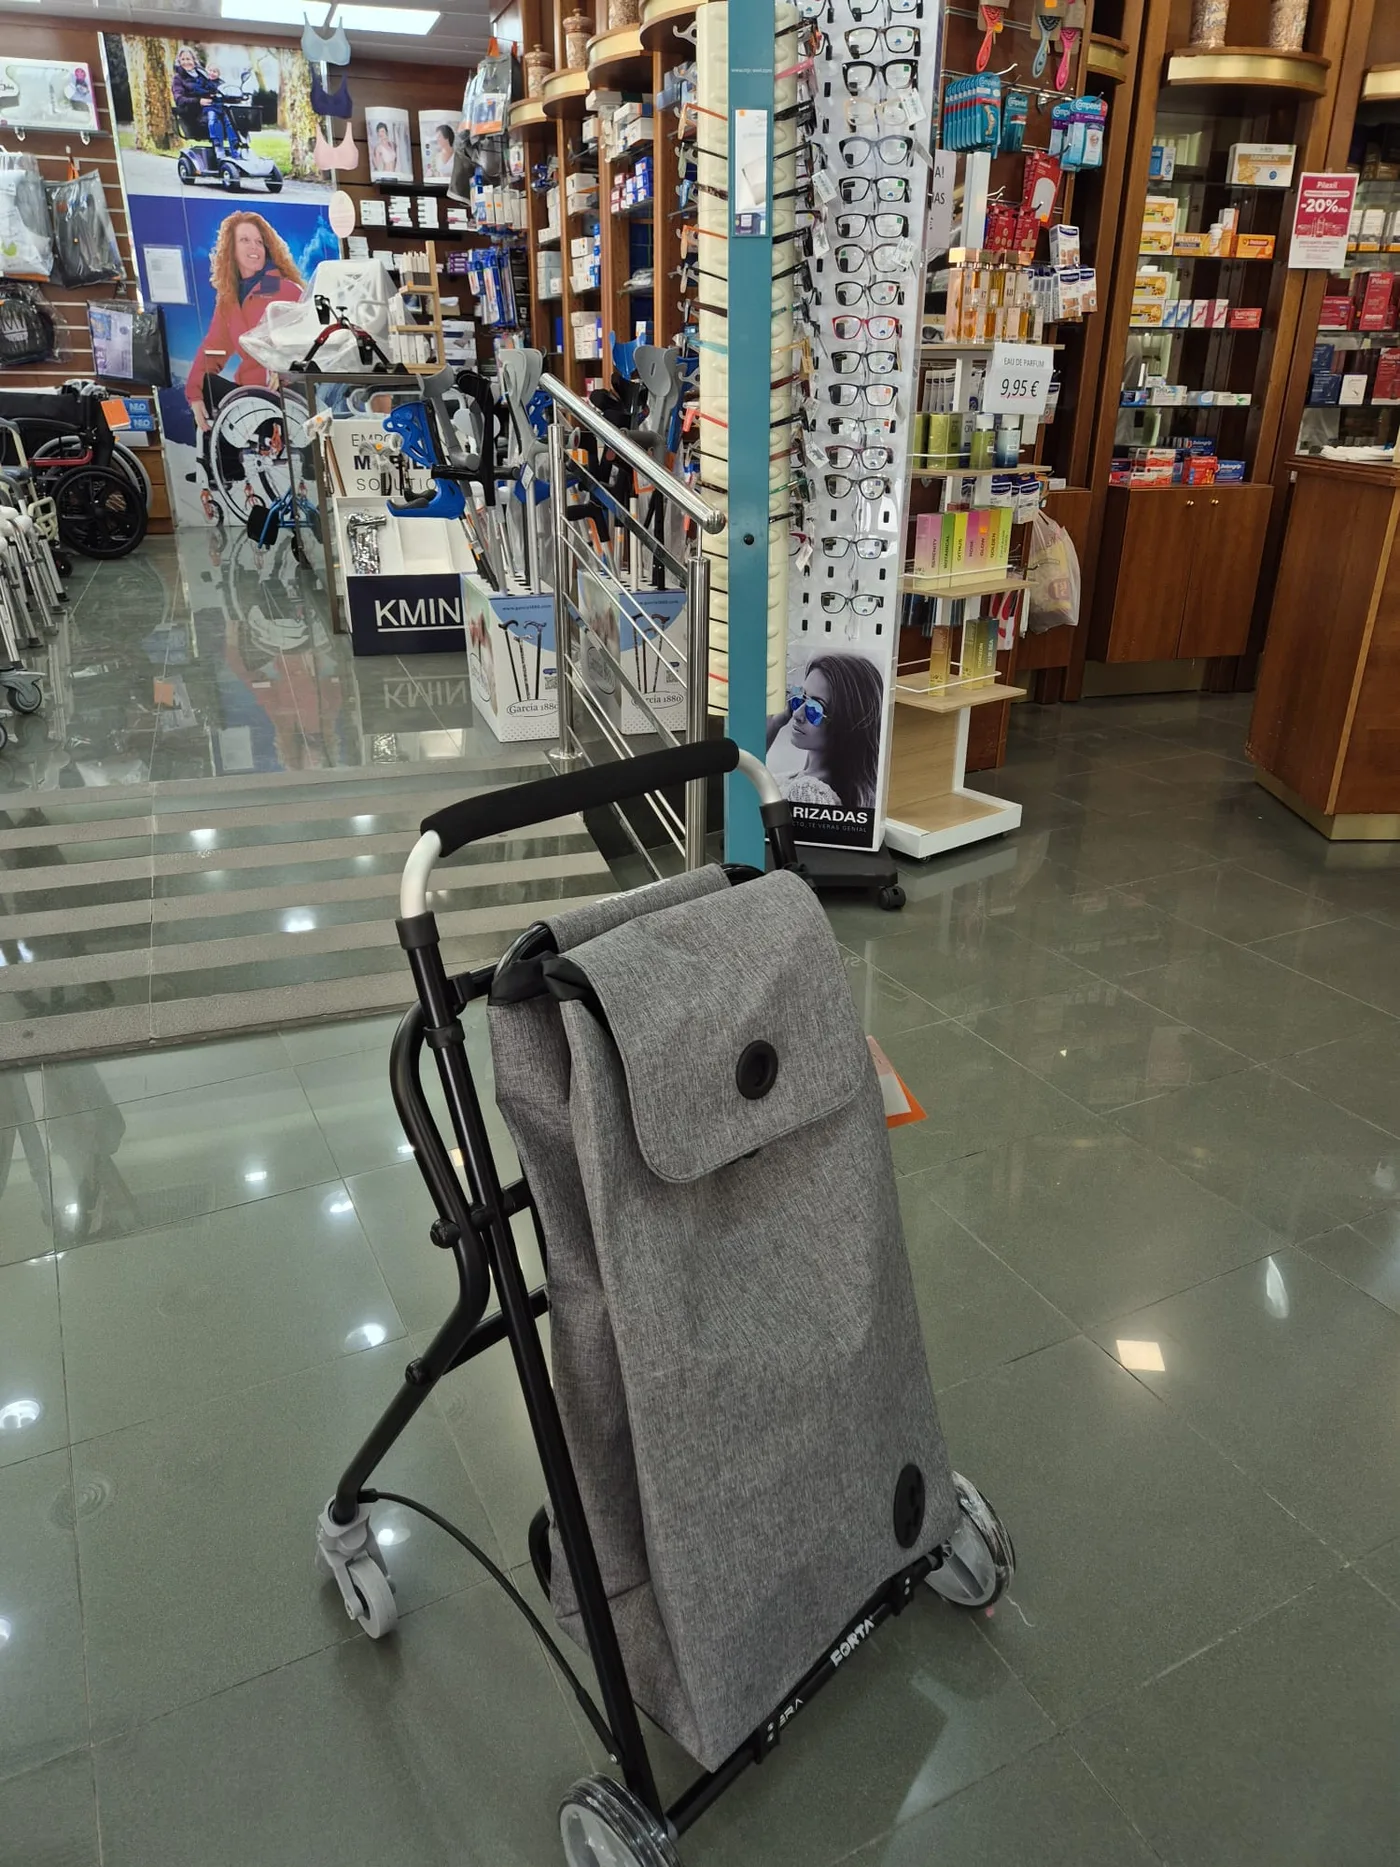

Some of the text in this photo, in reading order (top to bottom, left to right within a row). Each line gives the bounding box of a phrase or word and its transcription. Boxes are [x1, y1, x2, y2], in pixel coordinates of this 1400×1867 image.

[1076, 99, 1102, 111] Compeed
[935, 166, 944, 178] A!
[1301, 198, 1338, 213] -20%
[1004, 357, 1044, 368] EAU DE PARFUM
[1000, 378, 1040, 399] 9,95 €
[356, 478, 437, 491] SOUTIO
[663, 694, 682, 704] 1880
[842, 825, 867, 833] GENIAL
